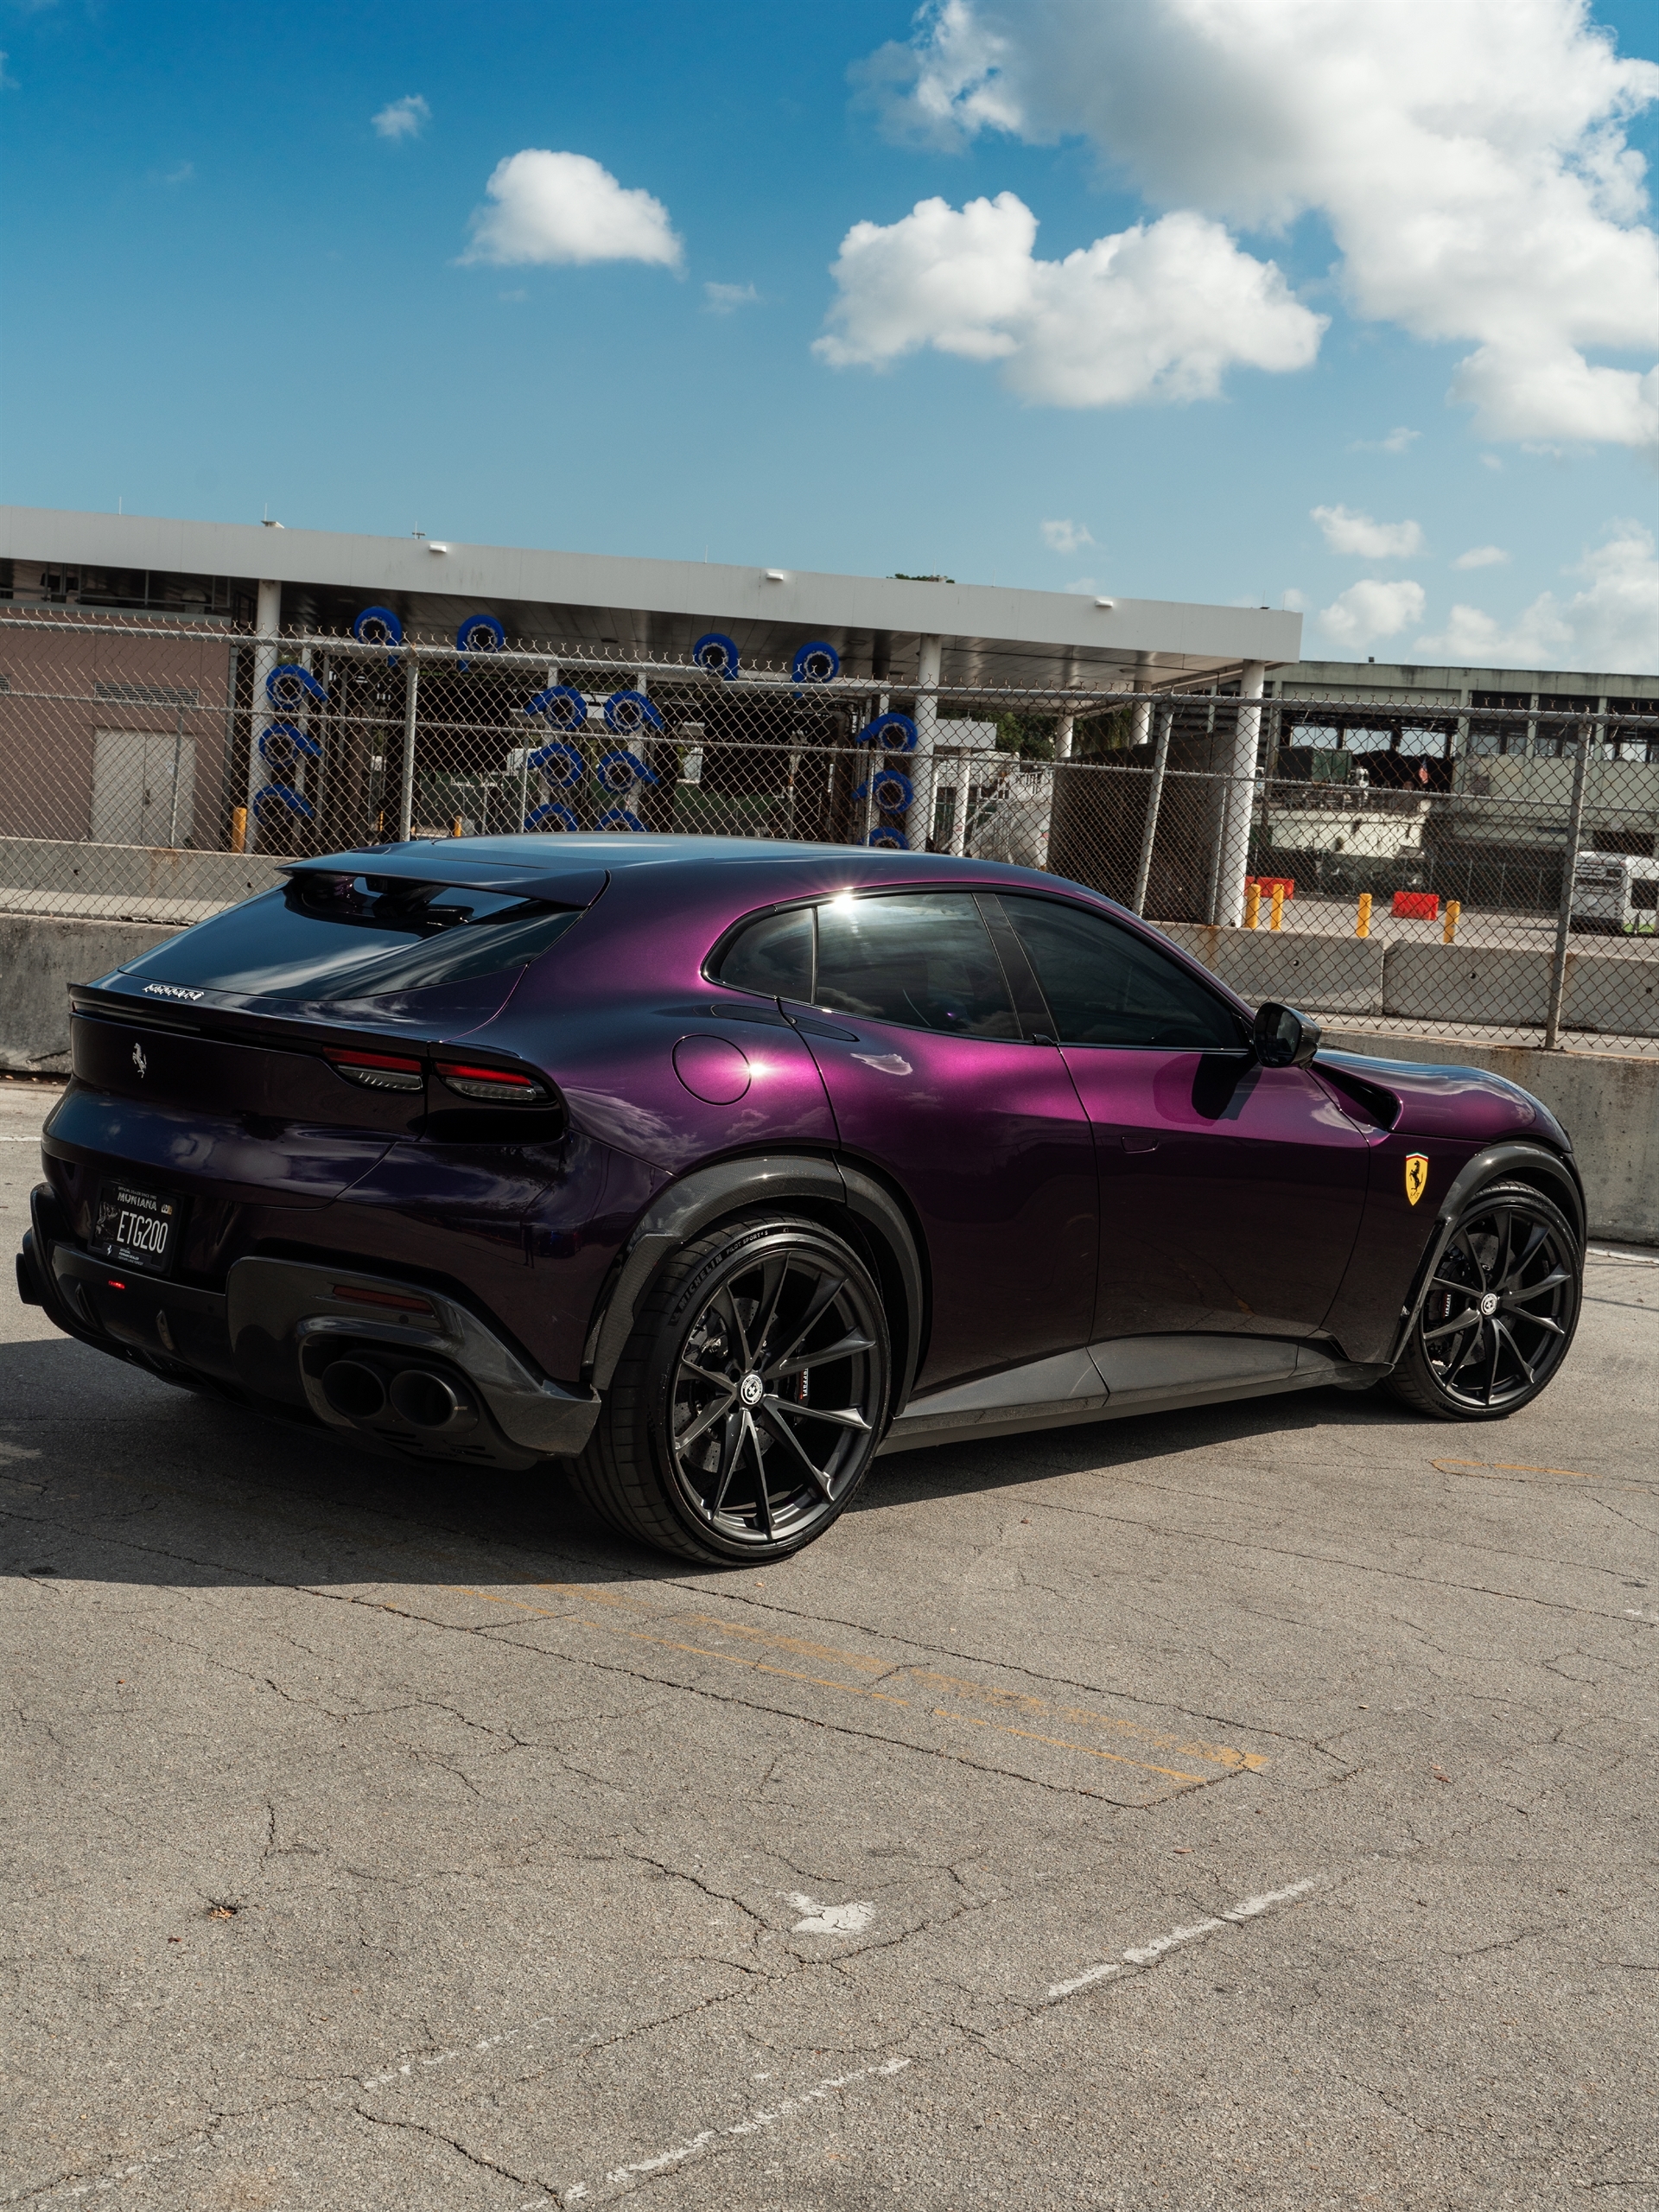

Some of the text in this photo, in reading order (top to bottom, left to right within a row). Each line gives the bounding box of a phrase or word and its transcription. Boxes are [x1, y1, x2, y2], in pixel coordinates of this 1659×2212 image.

[118, 1192, 157, 1211] MONTANA
[117, 1211, 168, 1254] ETG200
[678, 1254, 723, 1310] MICHELIN
[726, 1241, 741, 1255] PILOT
